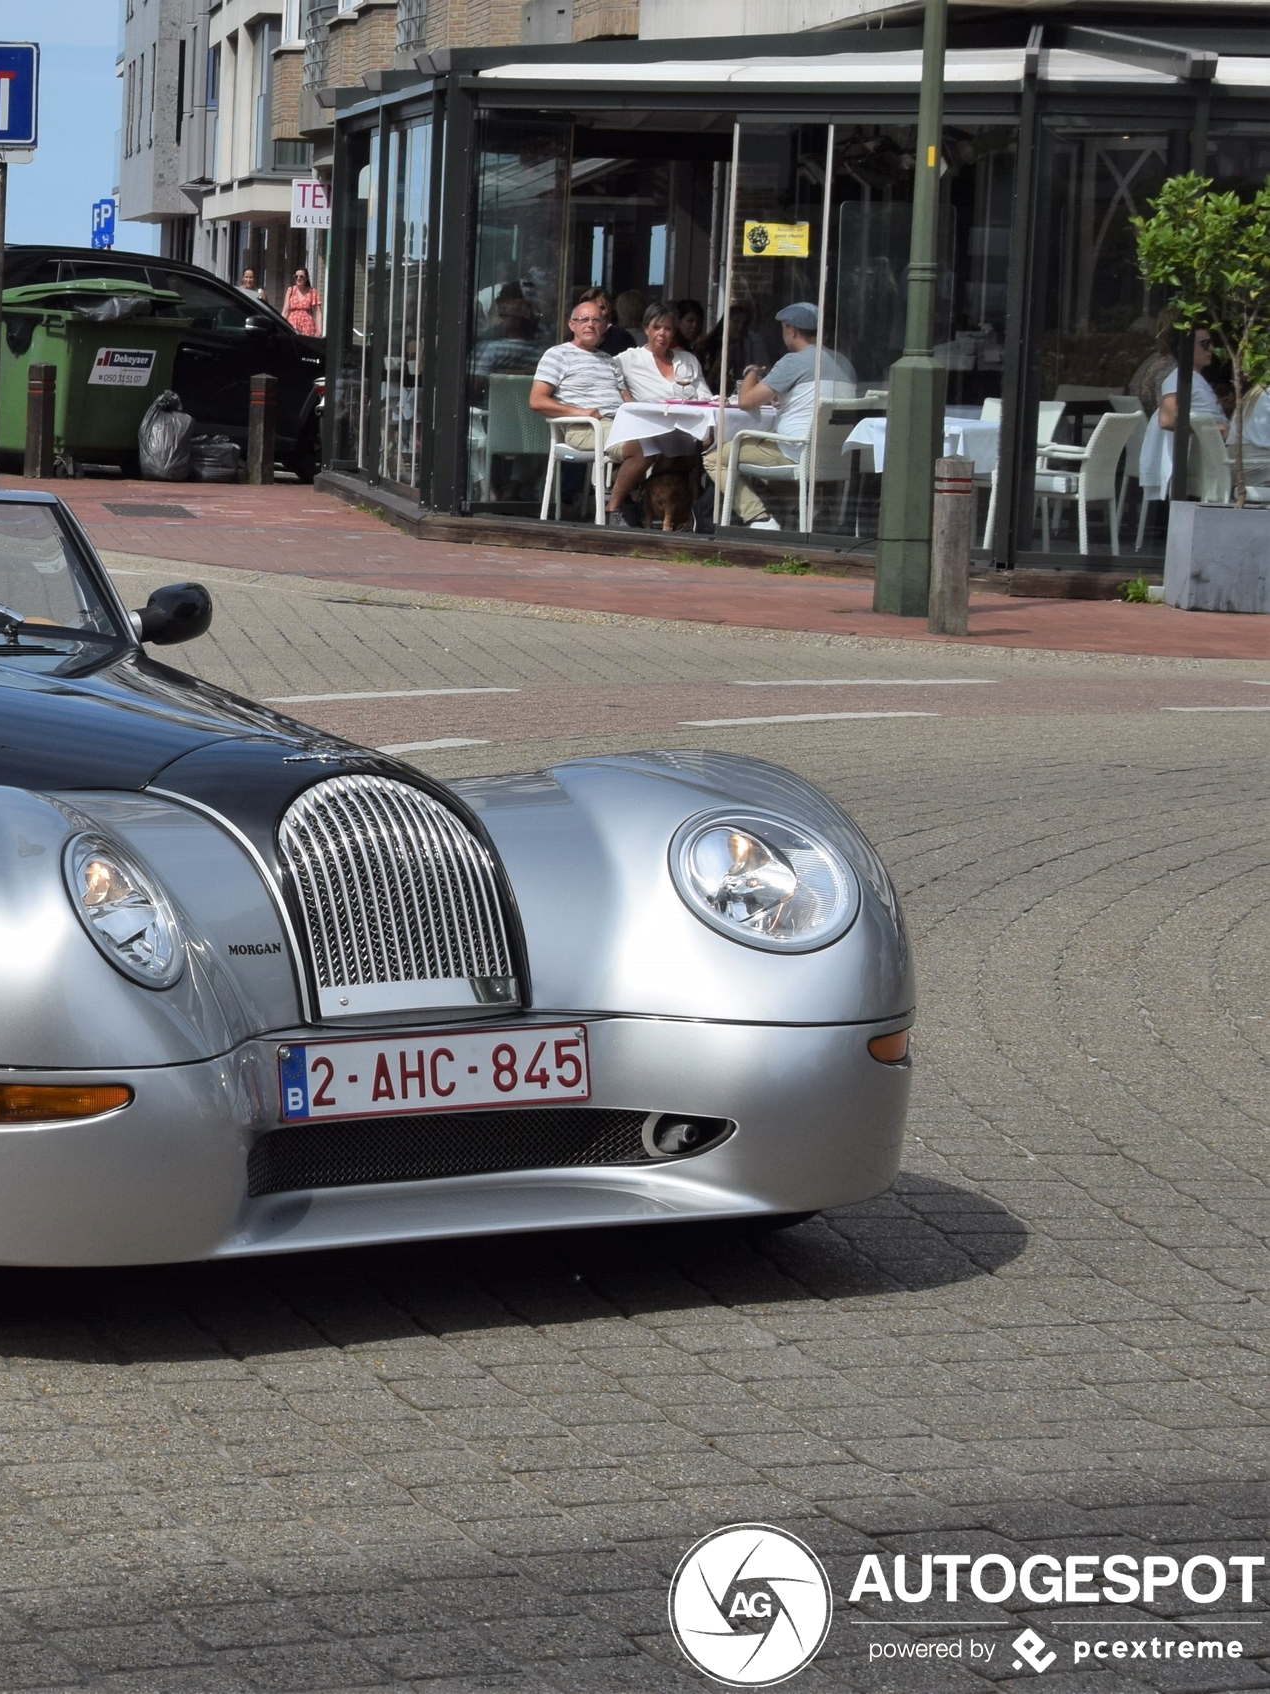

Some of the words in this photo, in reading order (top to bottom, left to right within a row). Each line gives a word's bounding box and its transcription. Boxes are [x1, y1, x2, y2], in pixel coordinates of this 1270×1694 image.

[101, 204, 112, 228] P
[113, 354, 149, 365] Dekeyser
[103, 374, 117, 382] 050
[134, 375, 142, 383] 07
[228, 943, 281, 956] MORGAN
[310, 1038, 582, 1107] 2-AHC-845
[287, 1087, 304, 1111] B
